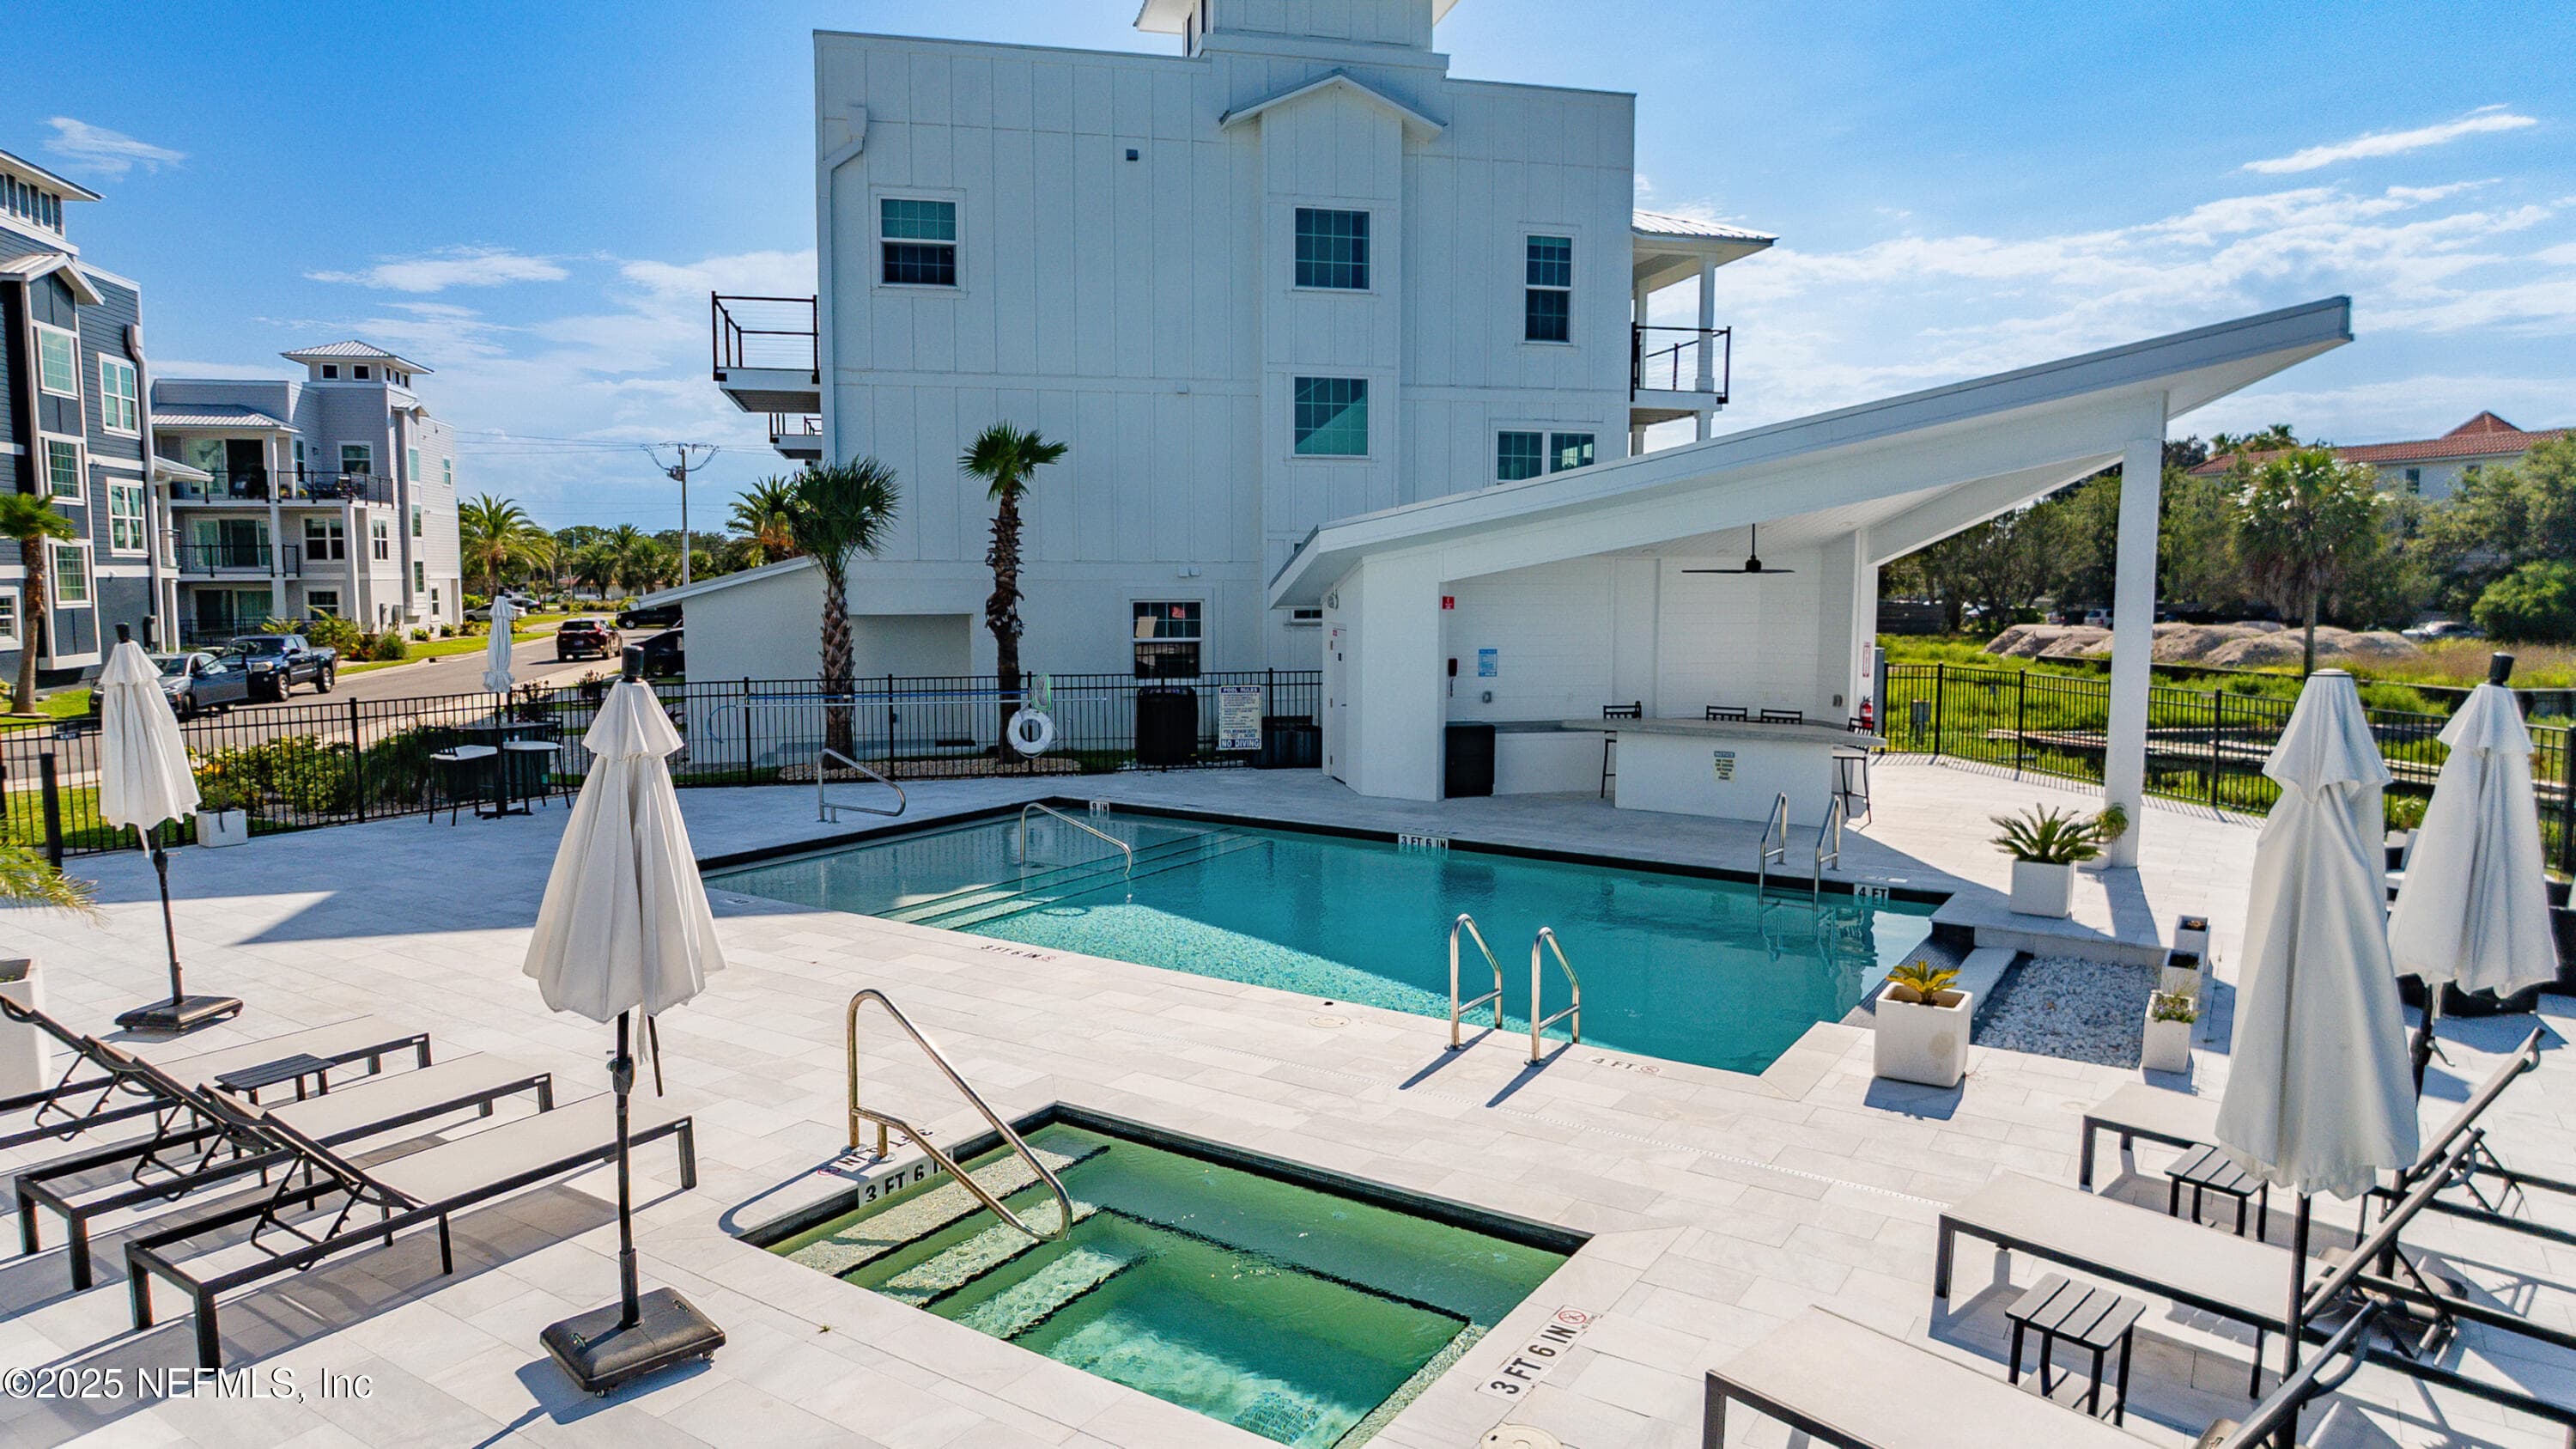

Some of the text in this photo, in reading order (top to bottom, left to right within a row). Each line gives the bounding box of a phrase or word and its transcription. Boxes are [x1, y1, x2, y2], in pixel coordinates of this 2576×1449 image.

[1235, 739, 1259, 747] DIVING
[1401, 836, 1407, 844] 3
[1411, 837, 1422, 846] FT
[1437, 838, 1446, 849] IN
[1858, 886, 1886, 898] 4 FT
[1611, 1061, 1637, 1069] FT
[866, 1184, 878, 1202] 3
[885, 1171, 906, 1195] FT
[914, 1164, 925, 1181] 6
[1491, 1324, 1577, 1394] 3 FT 6 IN
